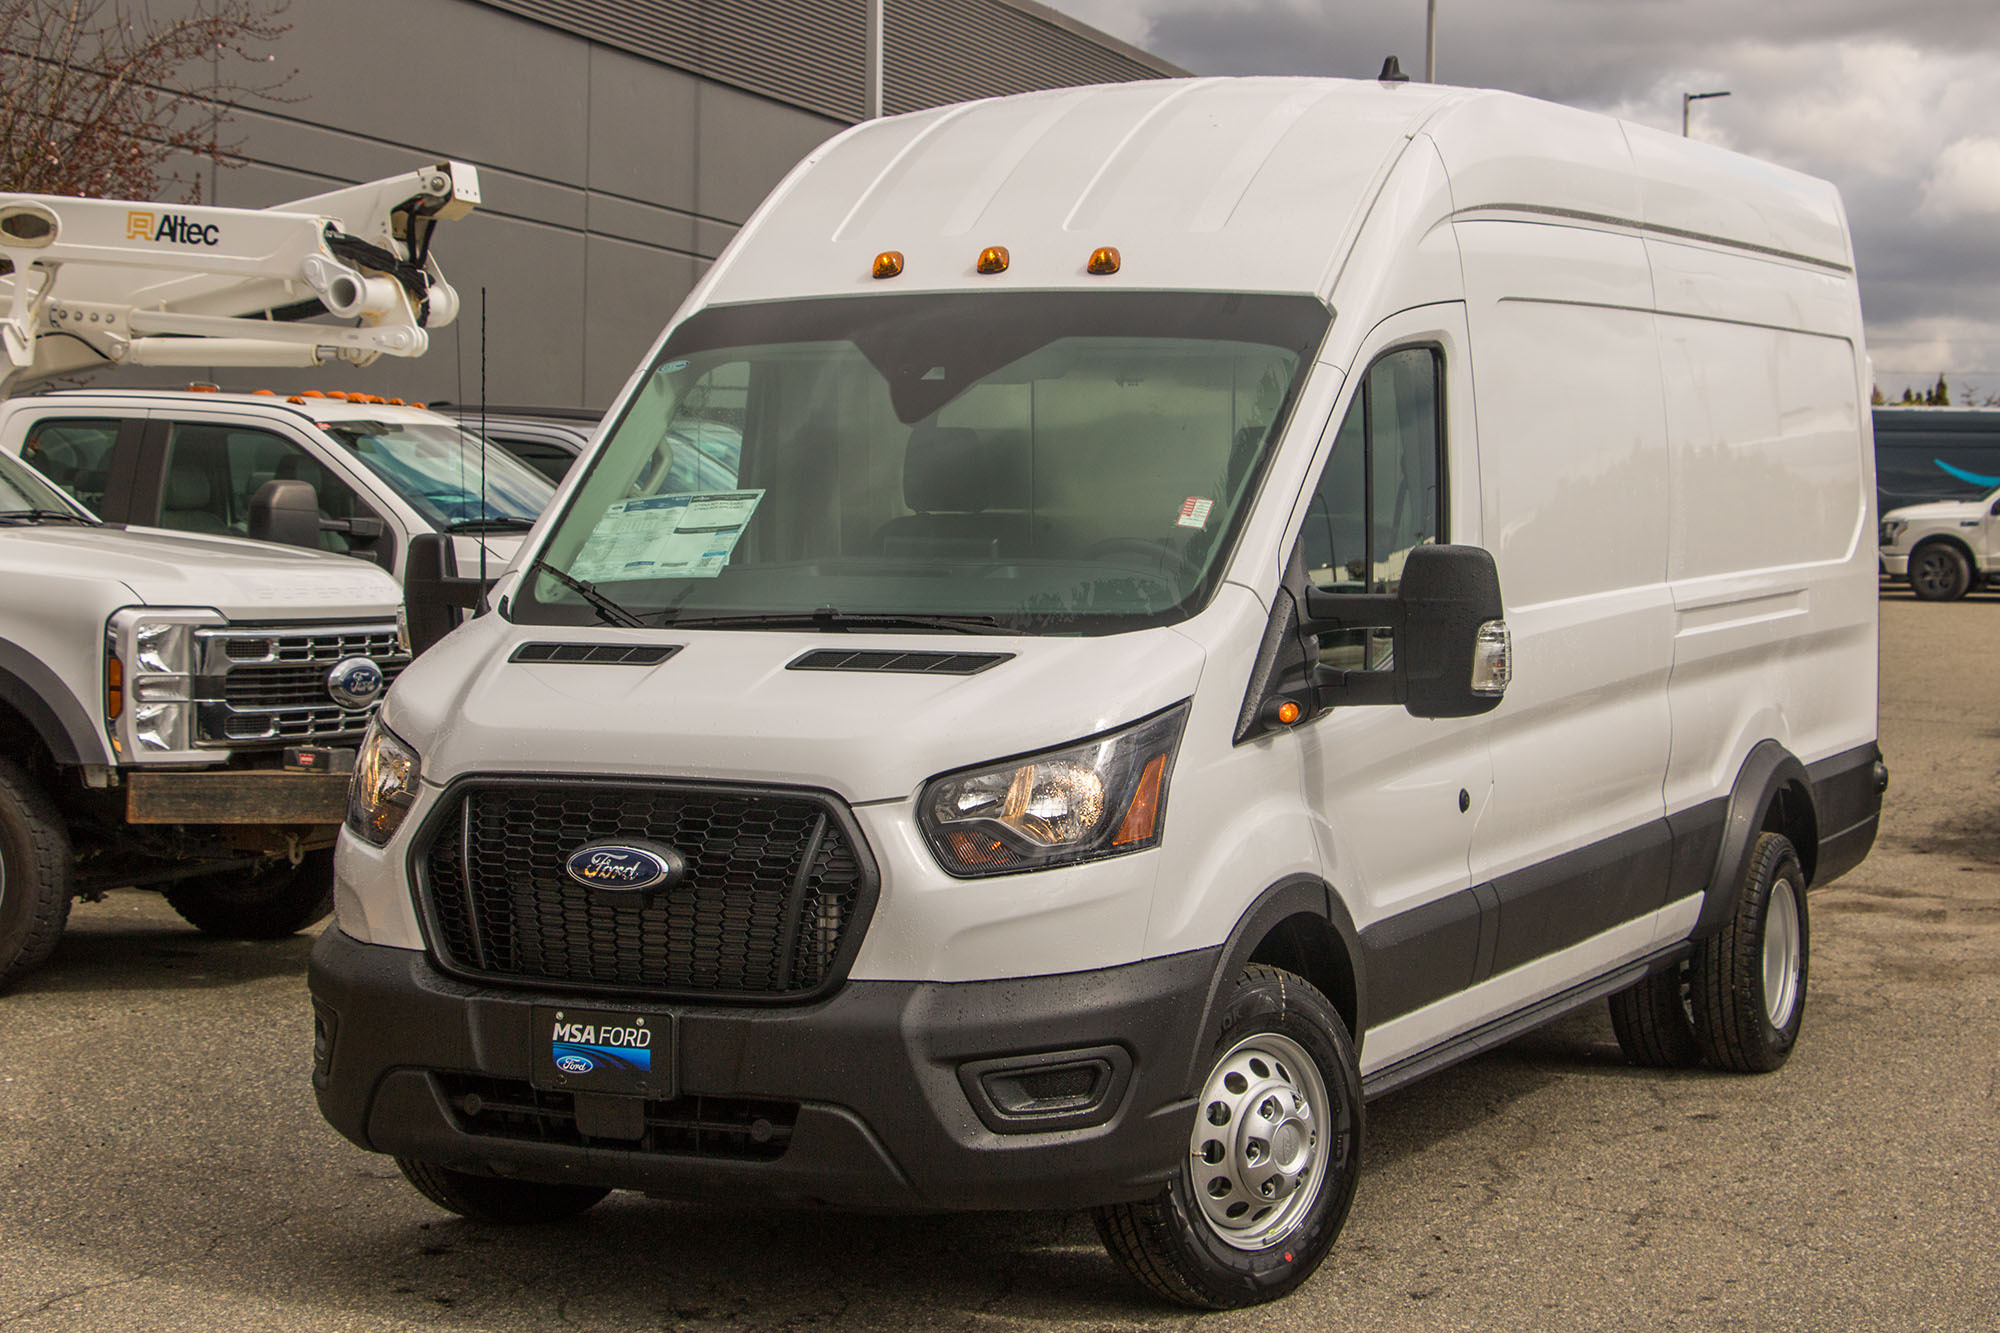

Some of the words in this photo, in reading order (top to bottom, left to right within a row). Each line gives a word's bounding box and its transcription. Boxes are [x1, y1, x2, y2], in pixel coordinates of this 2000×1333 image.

[155, 214, 220, 246] Altec
[350, 671, 377, 693] Ford
[584, 853, 639, 880] Ford
[552, 1022, 596, 1044] MSA
[598, 1026, 651, 1047] FORD
[562, 1059, 587, 1072] Ford
